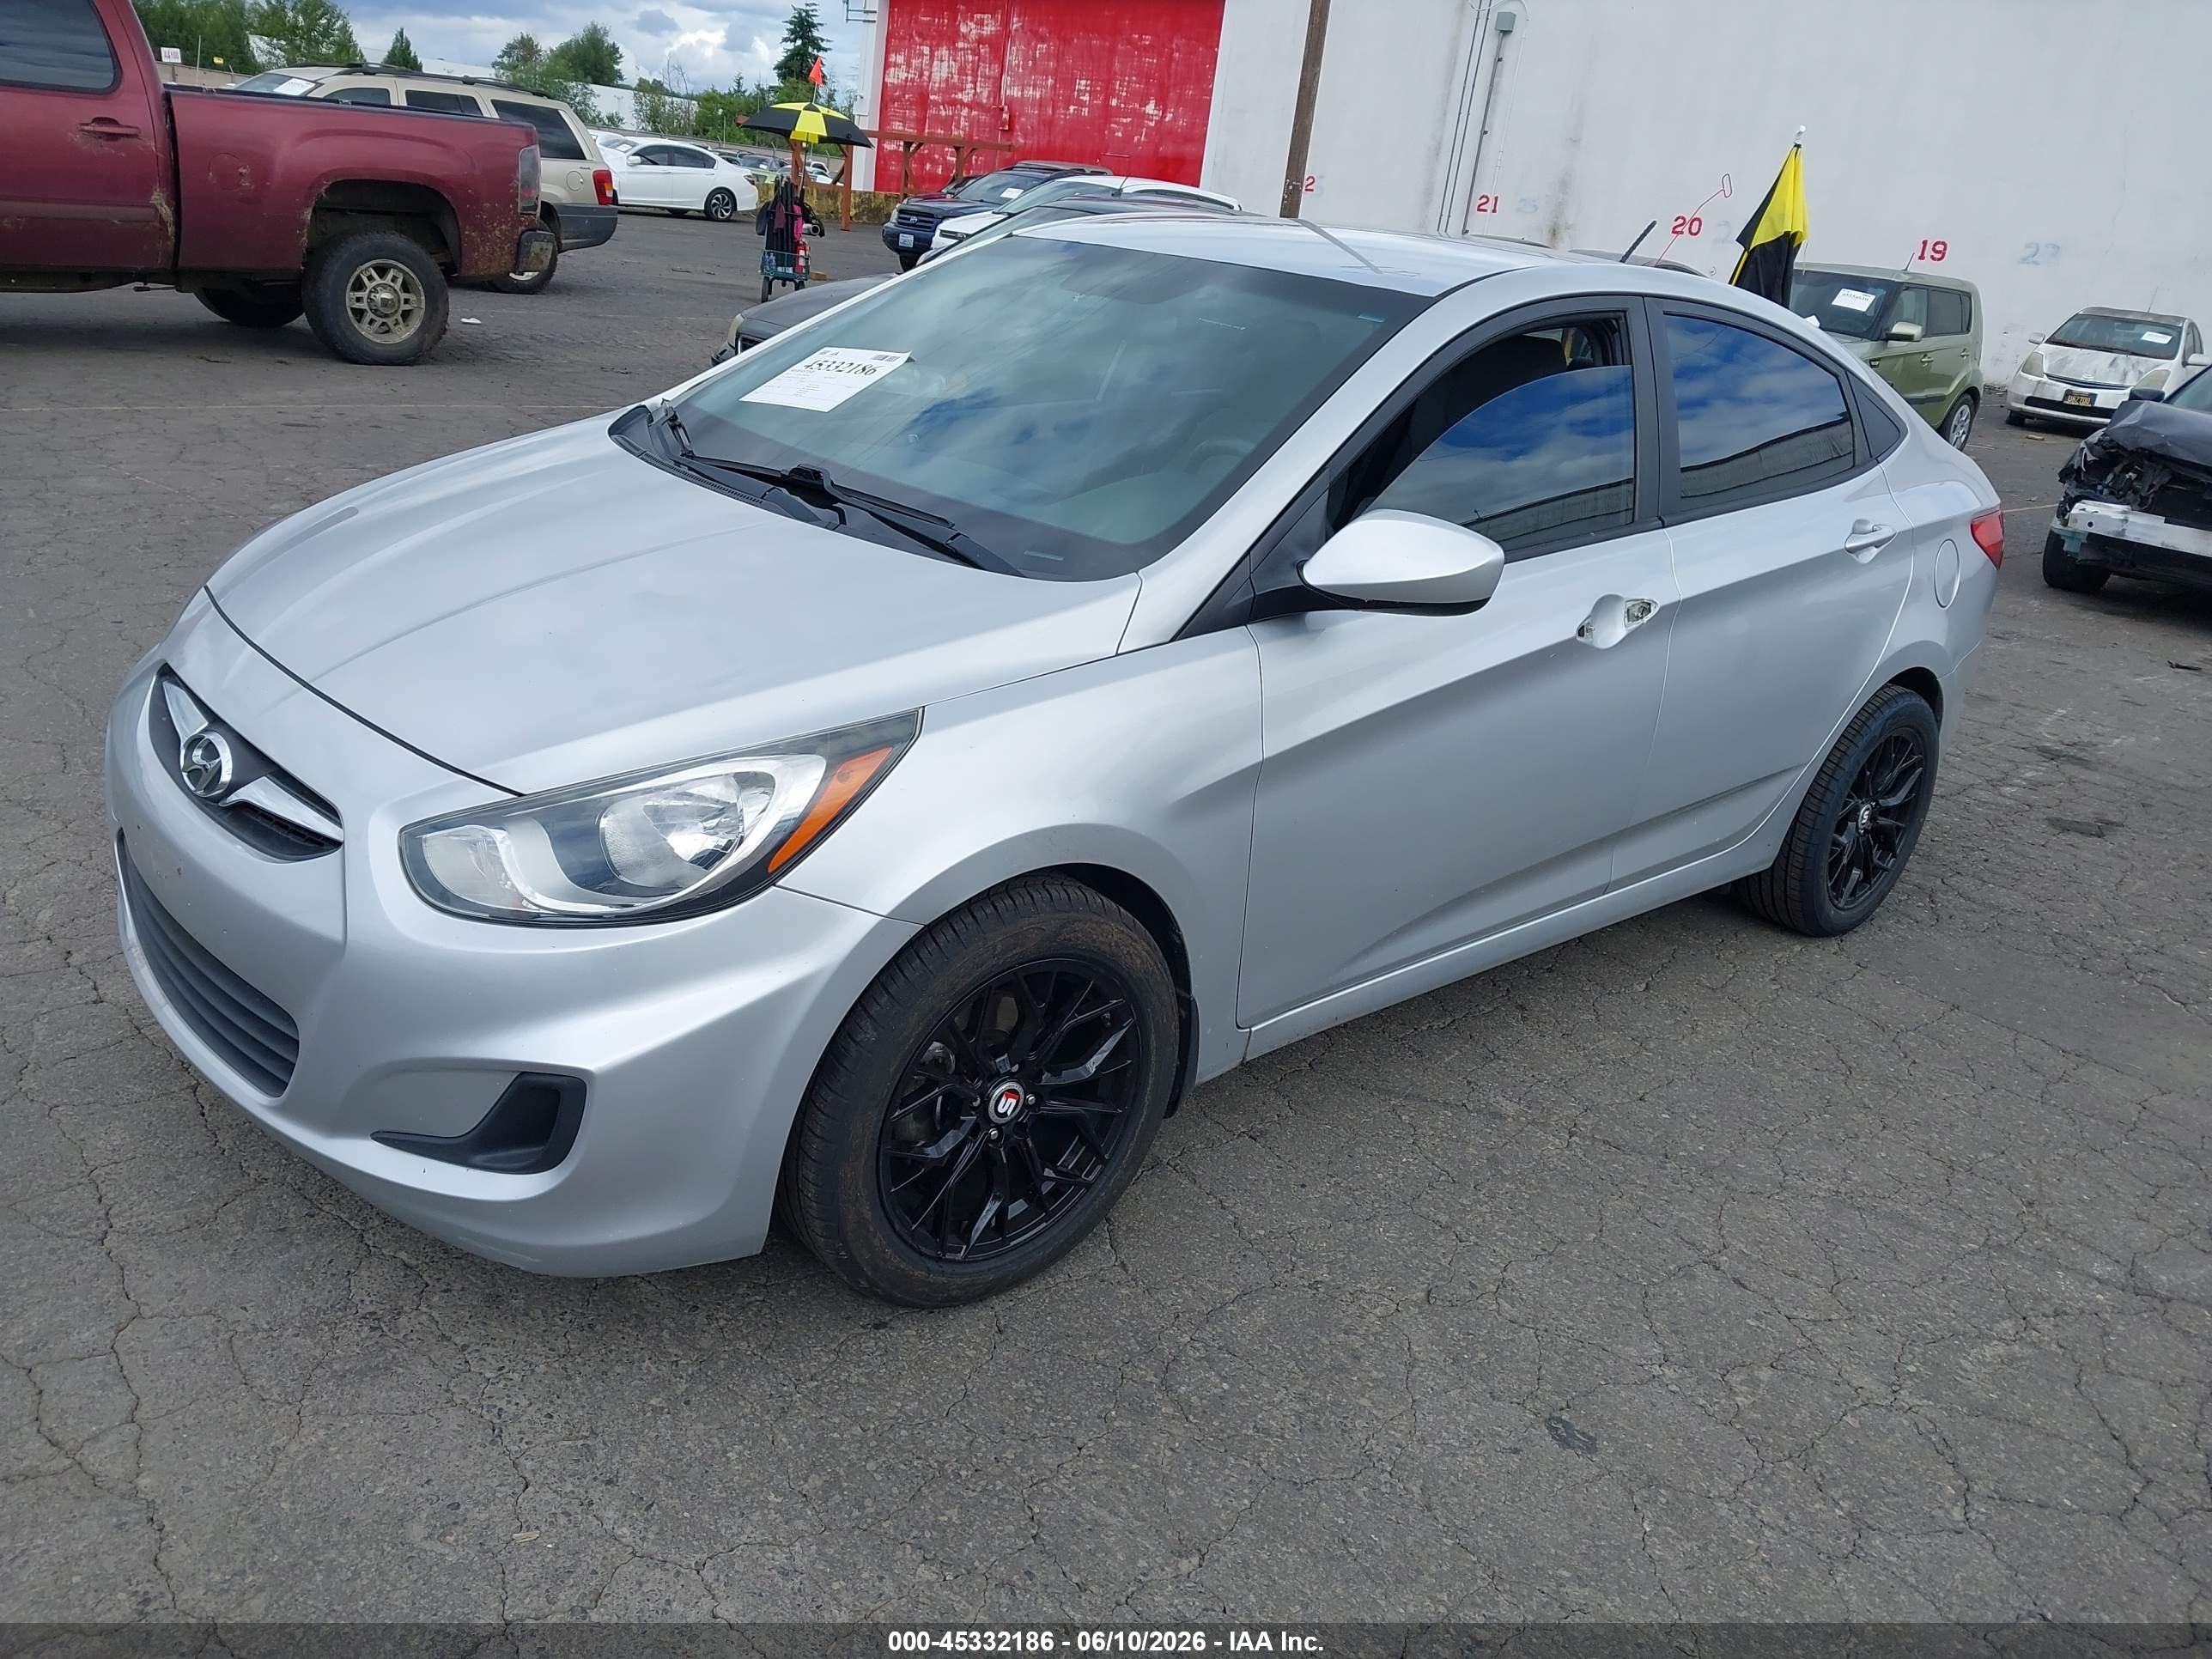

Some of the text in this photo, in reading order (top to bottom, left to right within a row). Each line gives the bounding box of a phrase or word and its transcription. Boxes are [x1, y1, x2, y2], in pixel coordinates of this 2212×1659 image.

[1476, 194, 1499, 214] 21
[1671, 216, 1703, 237] 20
[1917, 240, 1948, 262] 19
[804, 359, 882, 376] 45332186
